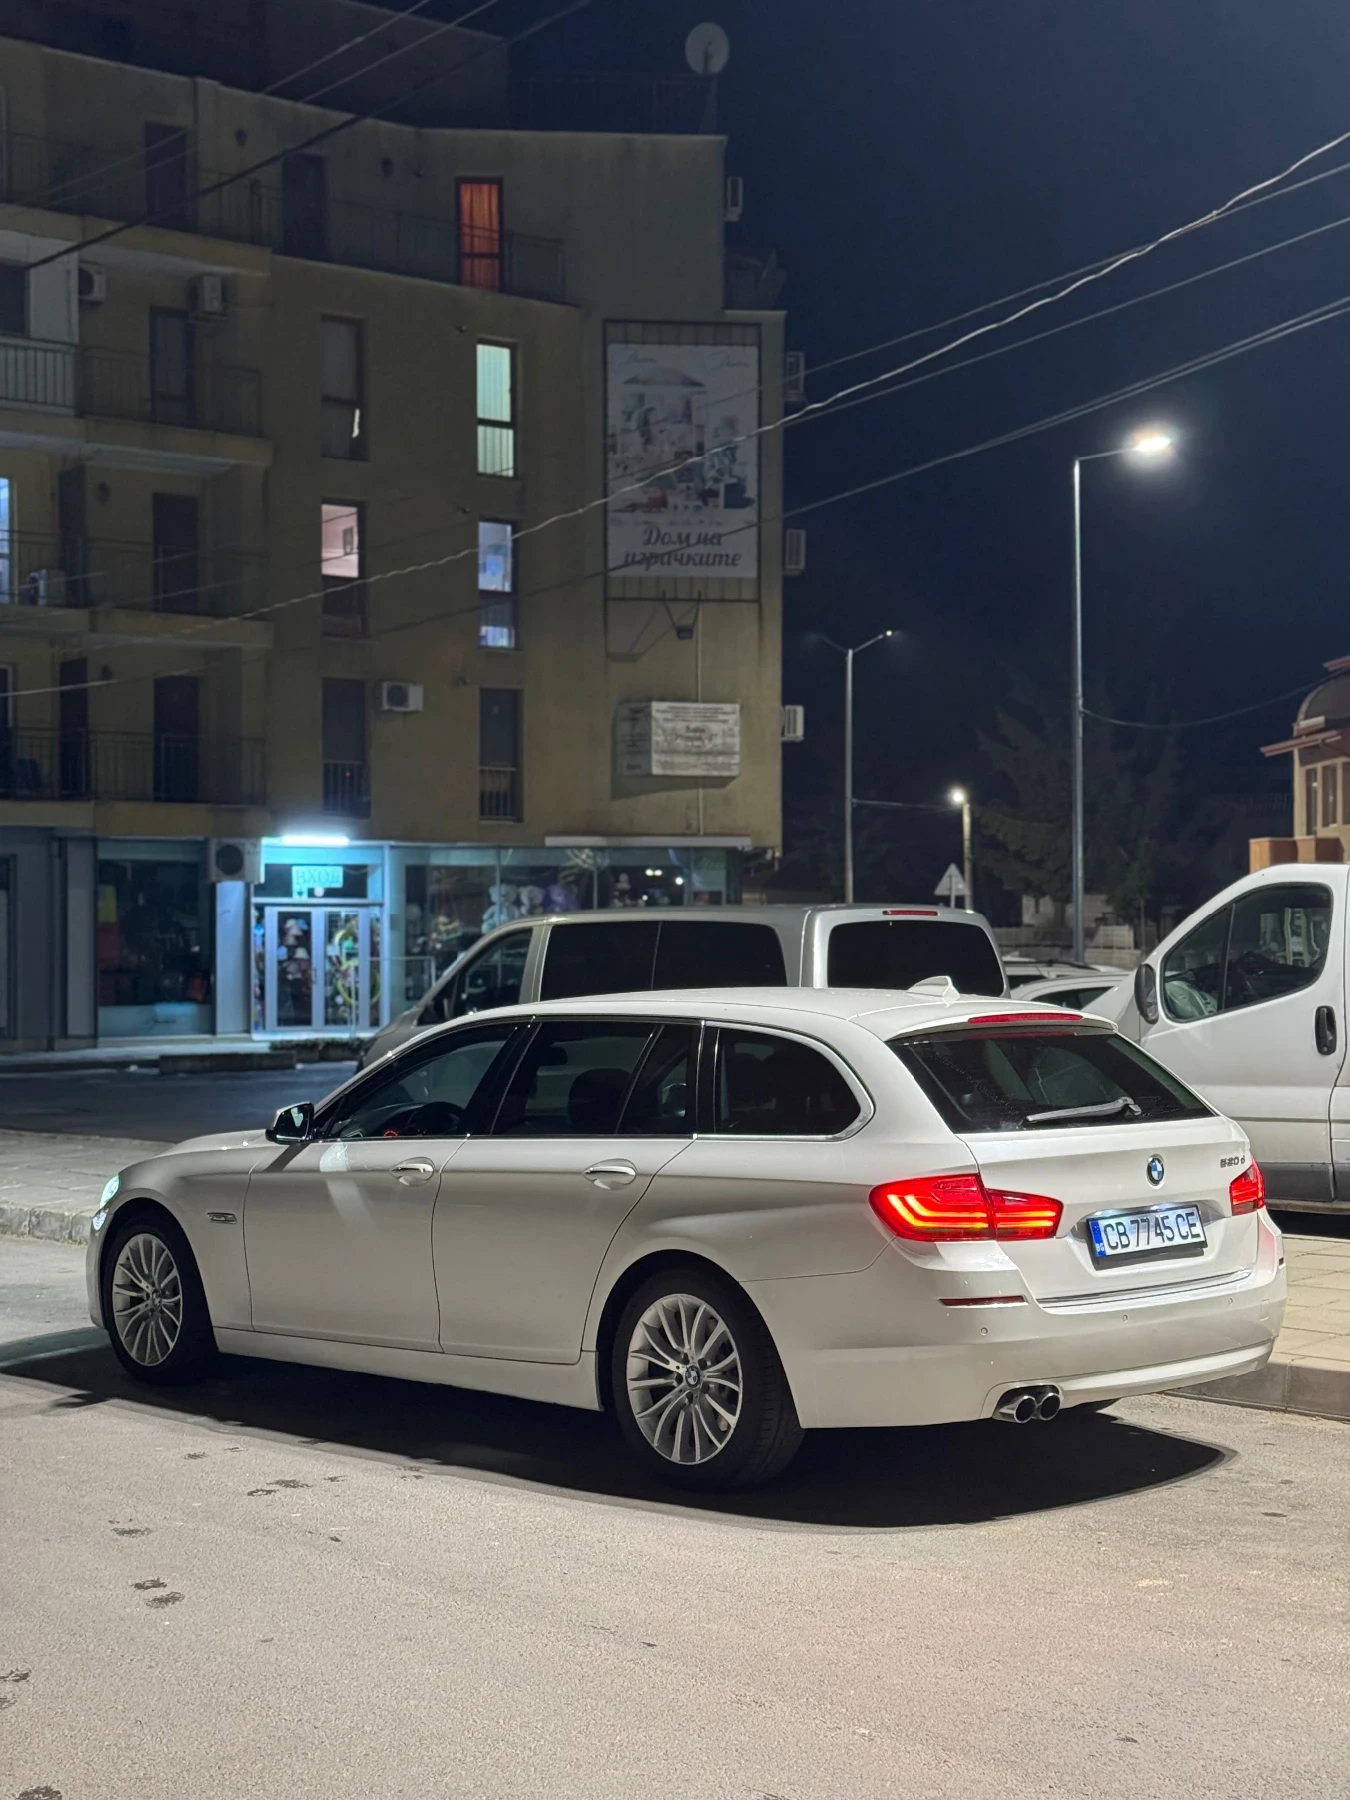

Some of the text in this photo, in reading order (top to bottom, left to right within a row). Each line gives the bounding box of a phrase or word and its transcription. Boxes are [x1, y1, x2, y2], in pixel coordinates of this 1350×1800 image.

[642, 526, 722, 547] Дом на
[623, 550, 742, 572] играчките
[295, 868, 342, 887] ВХОД
[1095, 1243, 1105, 1252] BG
